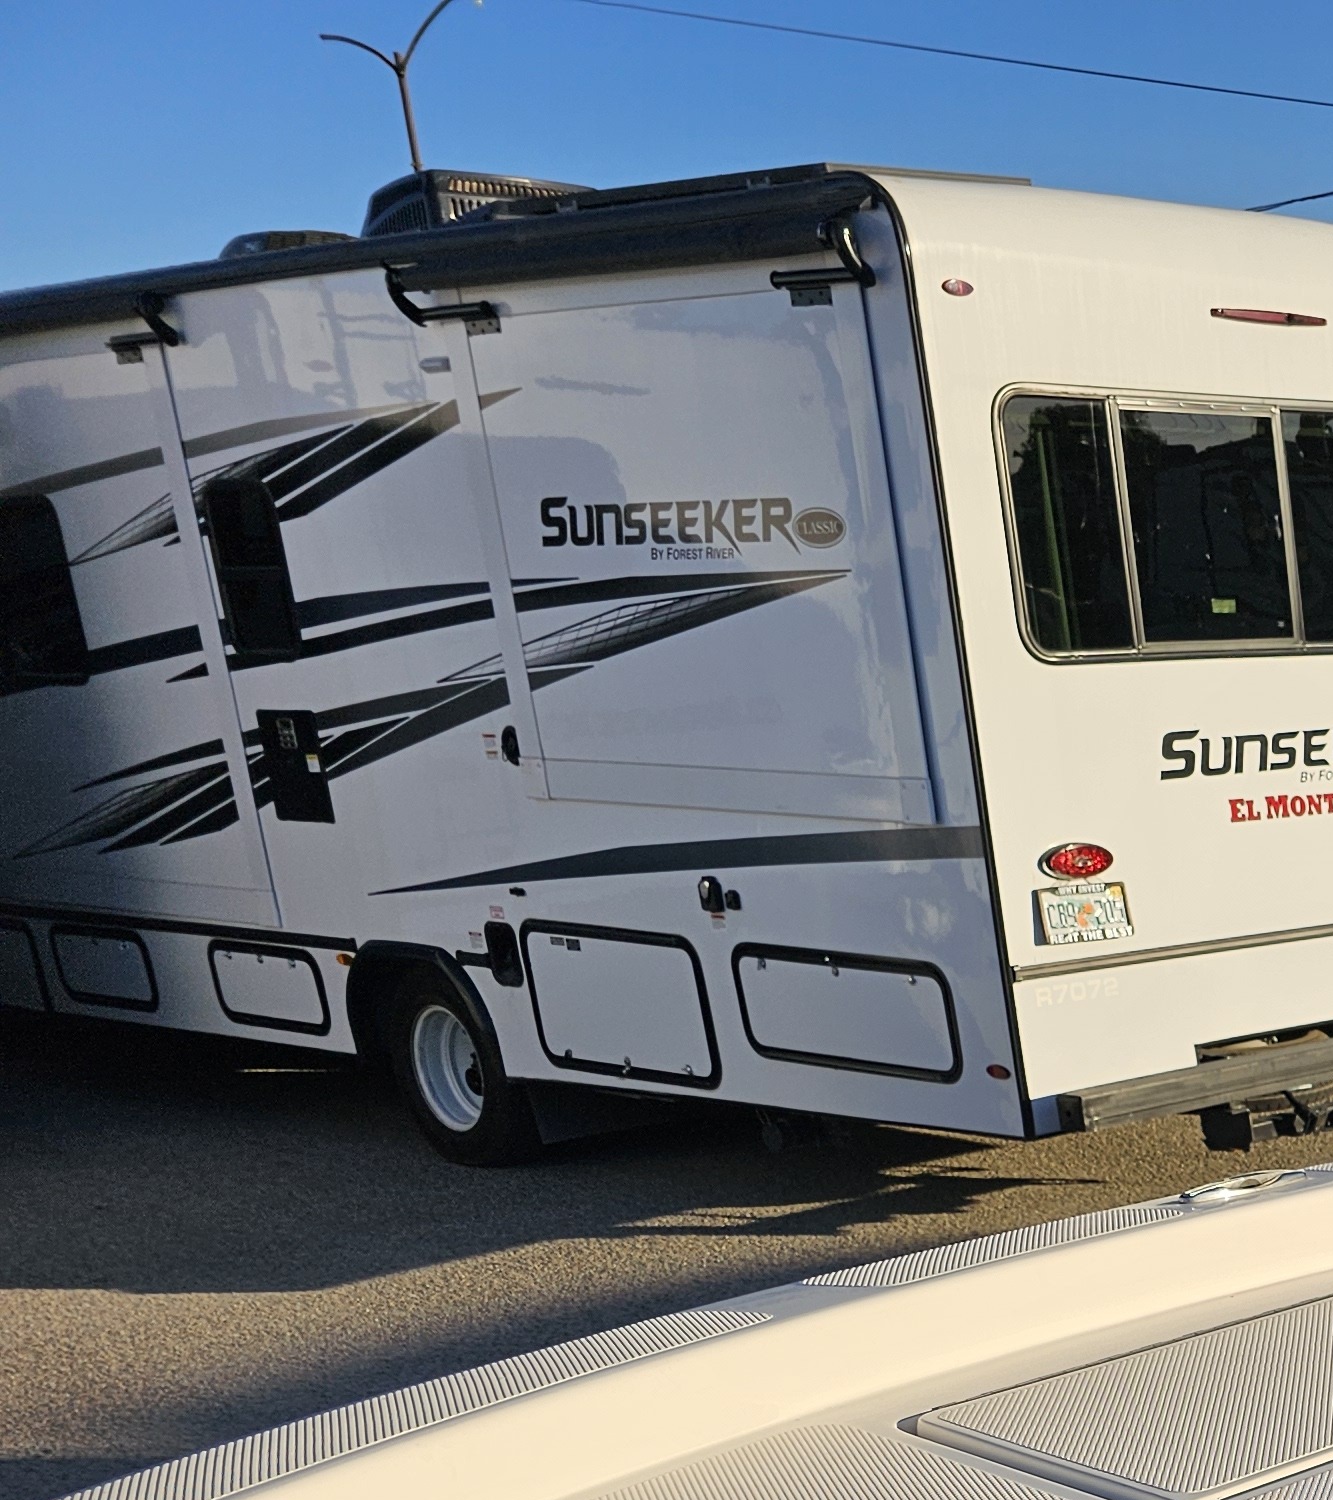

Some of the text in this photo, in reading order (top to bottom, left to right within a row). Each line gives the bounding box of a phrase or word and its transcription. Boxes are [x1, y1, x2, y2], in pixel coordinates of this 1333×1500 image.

[651, 547, 734, 560] BY FOREST RIVER
[1300, 771, 1314, 783] BY
[1228, 798, 1261, 823] EL
[1081, 929, 1104, 942] THE
[1104, 926, 1132, 939] BEST
